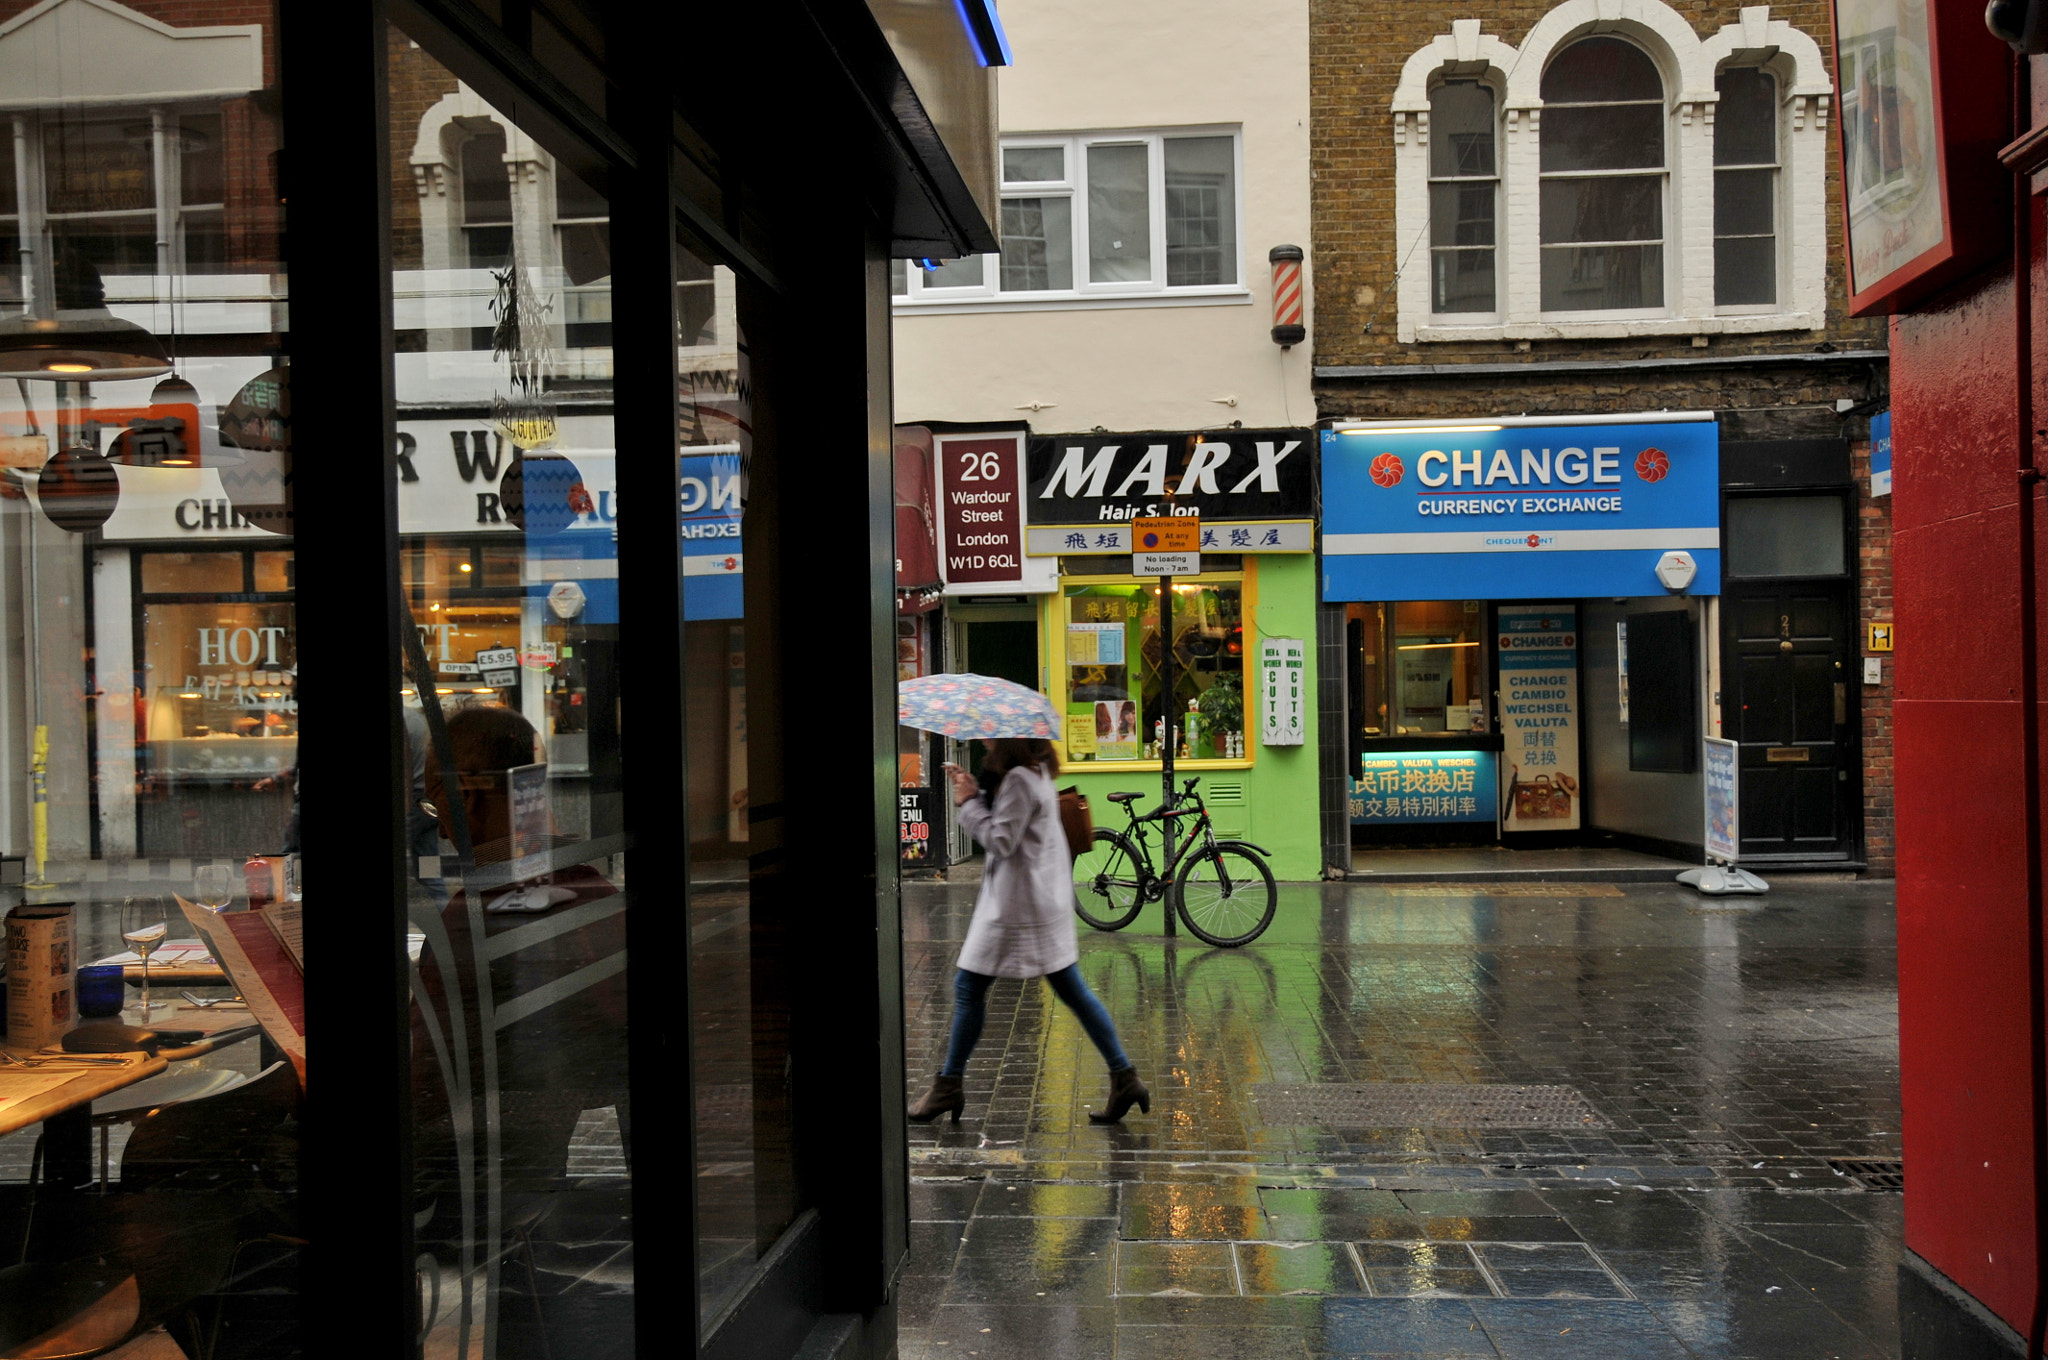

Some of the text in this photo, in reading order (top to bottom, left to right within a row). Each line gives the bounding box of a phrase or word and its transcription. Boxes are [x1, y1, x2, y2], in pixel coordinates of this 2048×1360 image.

[1324, 434, 1337, 442] 24
[960, 452, 1000, 481] 26
[1039, 440, 1301, 499] MARX
[1416, 446, 1622, 488] CHANGE
[951, 491, 1011, 506] Wardour
[1099, 503, 1200, 520] Hair Slon
[1417, 497, 1622, 516] CURRENCY EXCHANGE
[961, 509, 1003, 524] Street
[1178, 520, 1196, 528] Zone
[957, 532, 1009, 546] London
[1064, 528, 1283, 550] 飛短美髮屋
[950, 553, 1019, 569] W1D 6QL
[1159, 555, 1187, 563] loading
[197, 627, 286, 666] HOT
[1512, 636, 1563, 648] CHANGE
[479, 652, 514, 666] £5.95
[445, 664, 472, 672] OPEN
[1509, 676, 1567, 687] CHANGE
[1511, 690, 1566, 700] CAMBIO
[1506, 703, 1572, 714] WECHSEL
[1515, 718, 1568, 728] VALUTA
[1366, 760, 1398, 768] CAMBIO
[1402, 759, 1433, 767] VALUTA
[1349, 769, 1476, 794] 民币找换店
[901, 809, 923, 822] ENU
